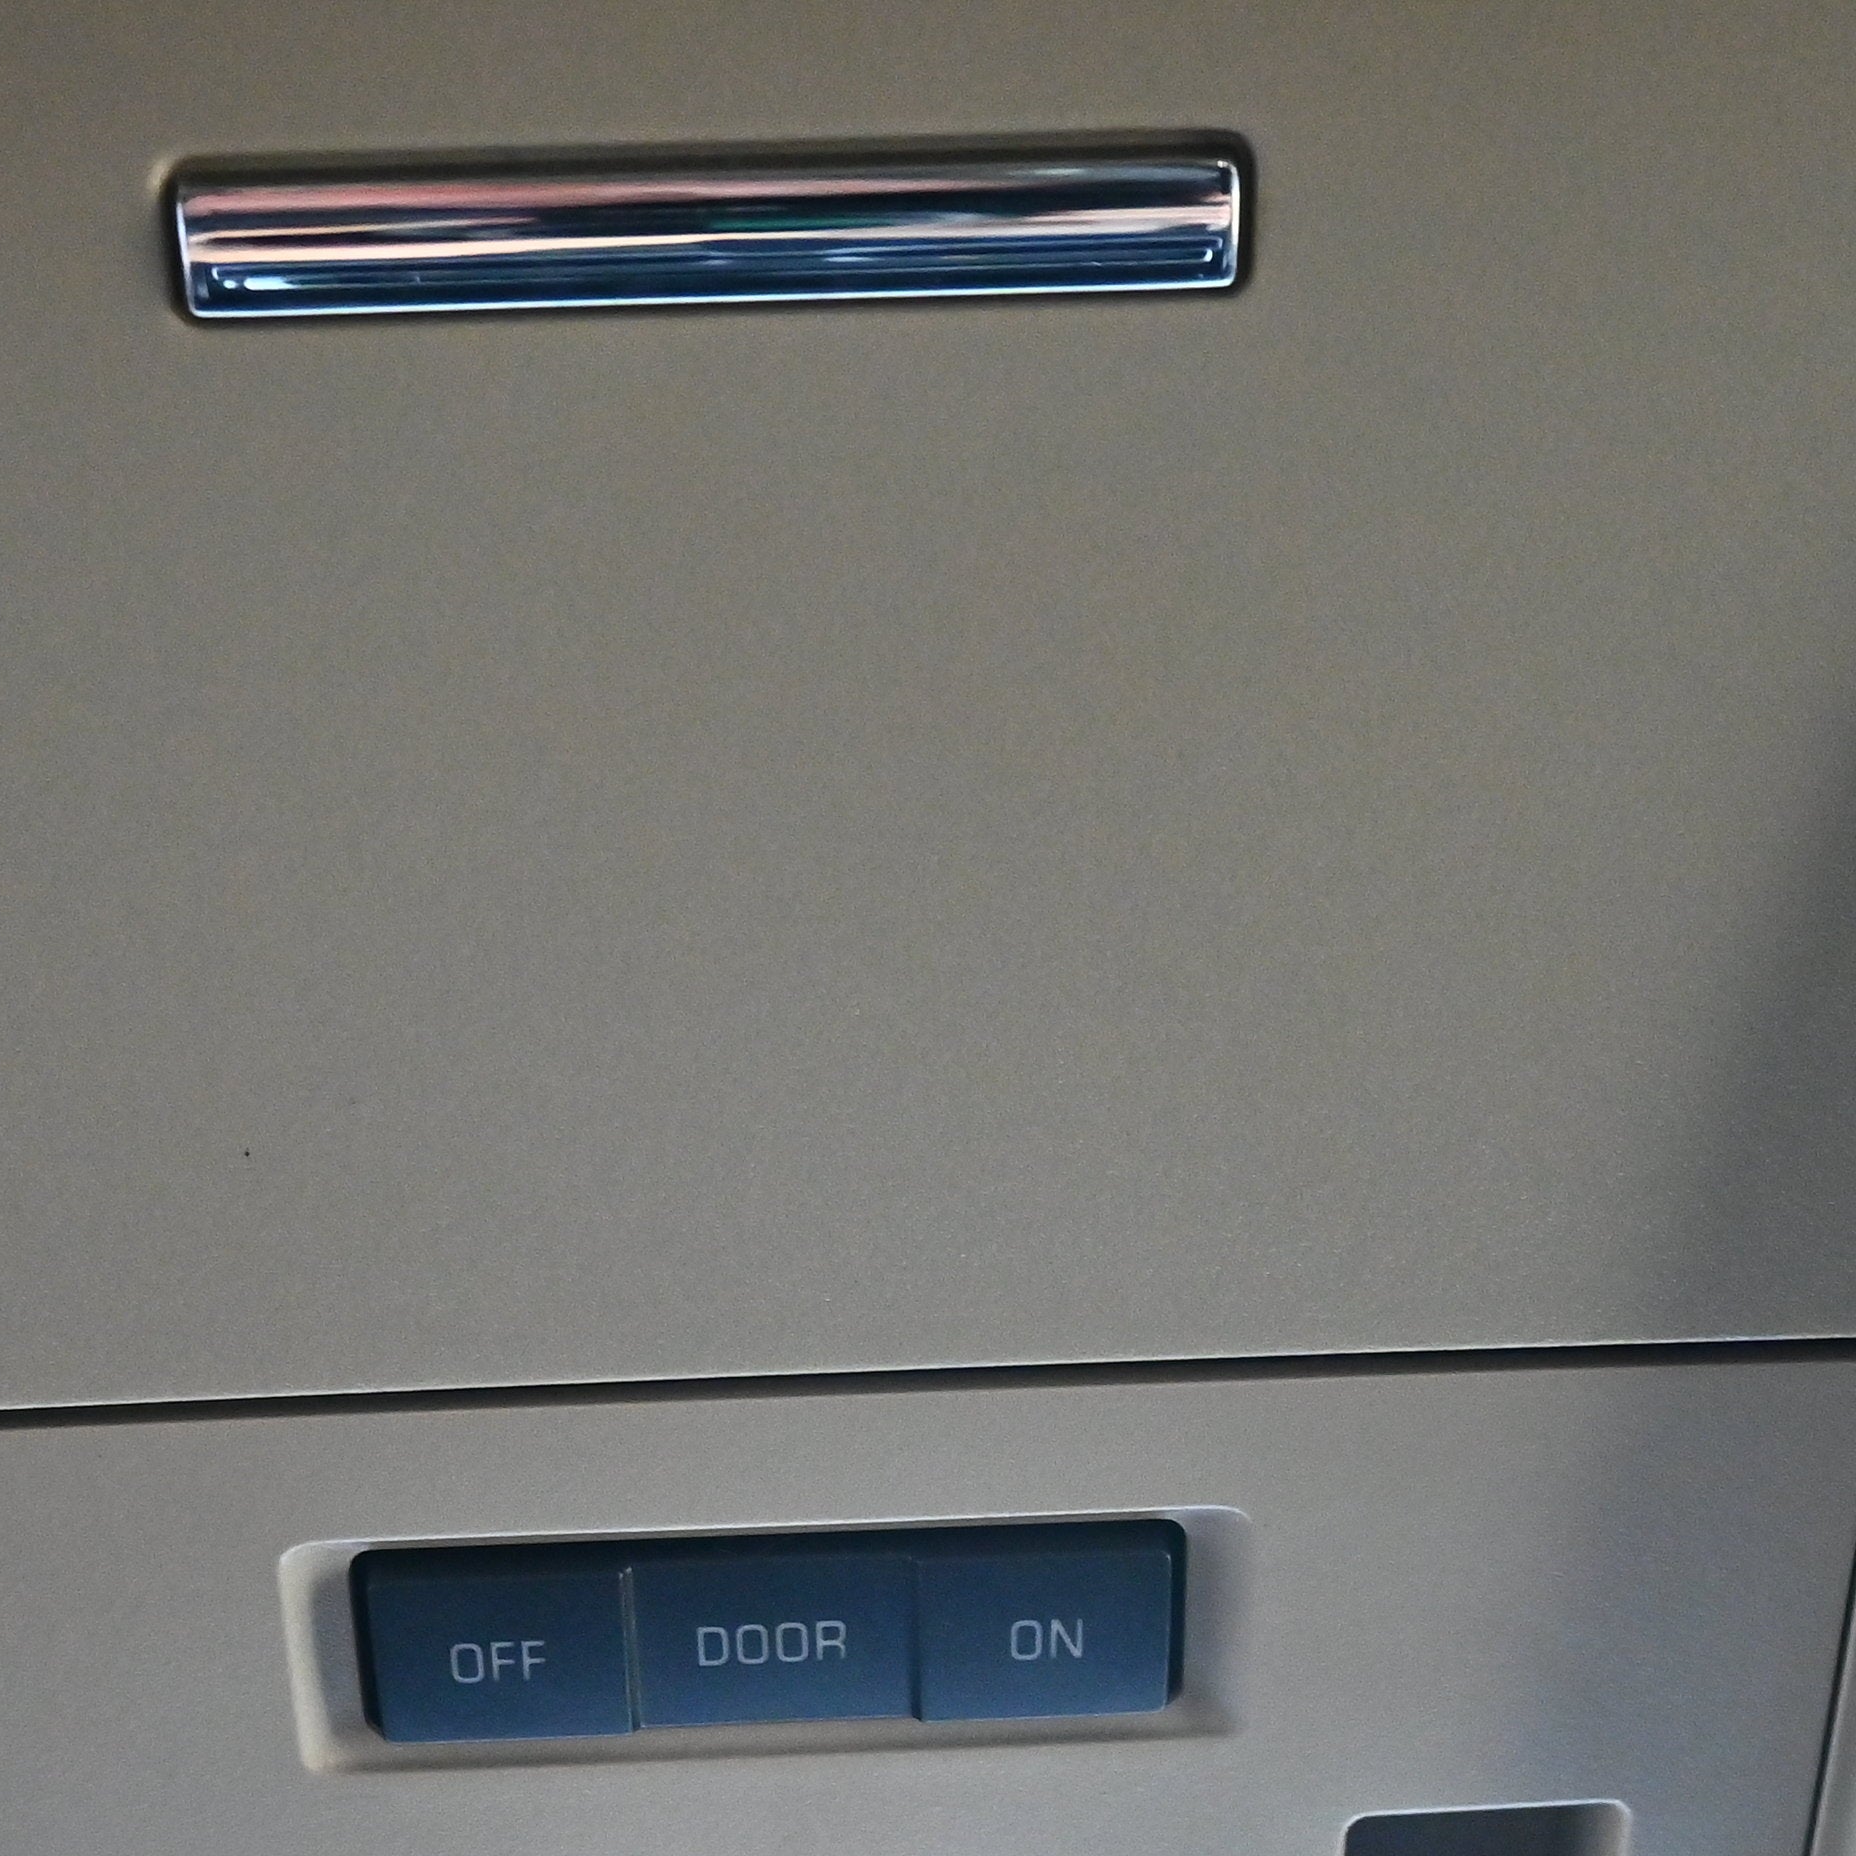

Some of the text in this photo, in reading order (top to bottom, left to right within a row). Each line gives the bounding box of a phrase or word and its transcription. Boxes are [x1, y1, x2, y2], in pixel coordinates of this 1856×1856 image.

[449, 1639, 547, 1684] OFF
[696, 1619, 848, 1667] DOOR
[1009, 1618, 1085, 1662] ON
